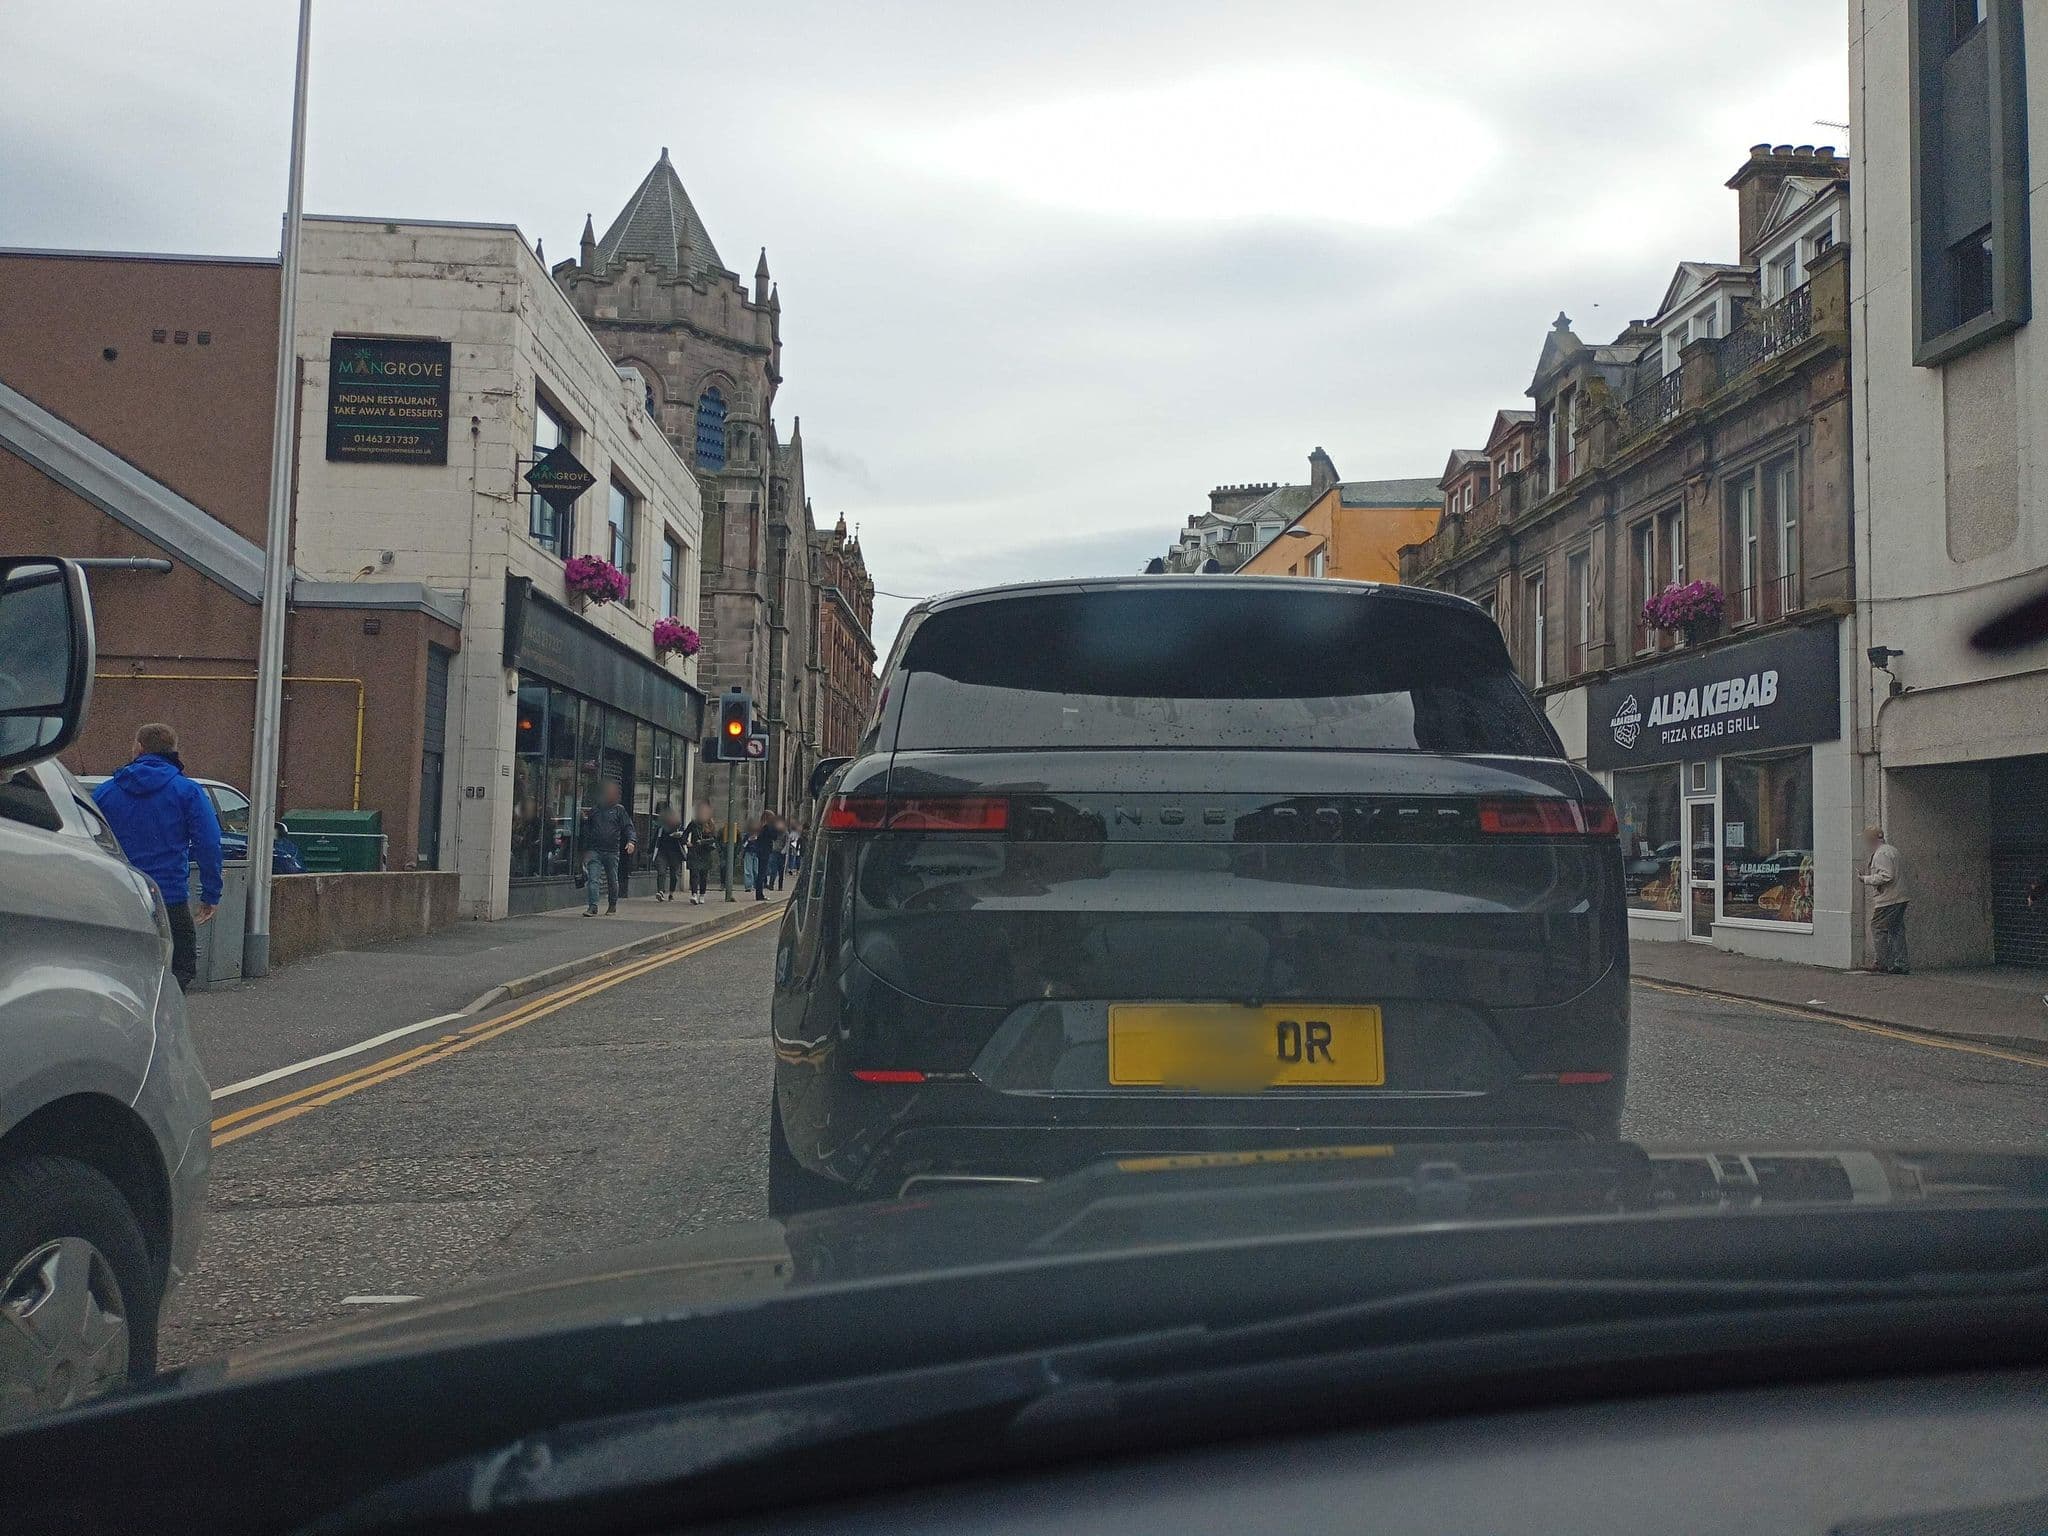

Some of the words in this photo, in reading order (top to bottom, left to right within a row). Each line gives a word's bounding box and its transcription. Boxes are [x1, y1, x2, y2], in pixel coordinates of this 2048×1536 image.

[338, 360, 443, 377] MANGROVE
[340, 395, 375, 404] INDIAN
[377, 396, 438, 407] RESTAURANT,
[334, 406, 357, 415] TAKE
[359, 407, 387, 416] AWAY
[388, 408, 396, 417] &
[398, 408, 443, 418] DESSERTS
[354, 434, 383, 444] 01463
[385, 435, 420, 445] 217337
[530, 471, 591, 481] MANGROVE
[1647, 687, 1700, 728] ALBA
[1701, 670, 1779, 718] KEBAB
[1661, 728, 1688, 745] PIZZA
[1690, 721, 1724, 741] KEBAB
[1727, 715, 1760, 734] GRILL
